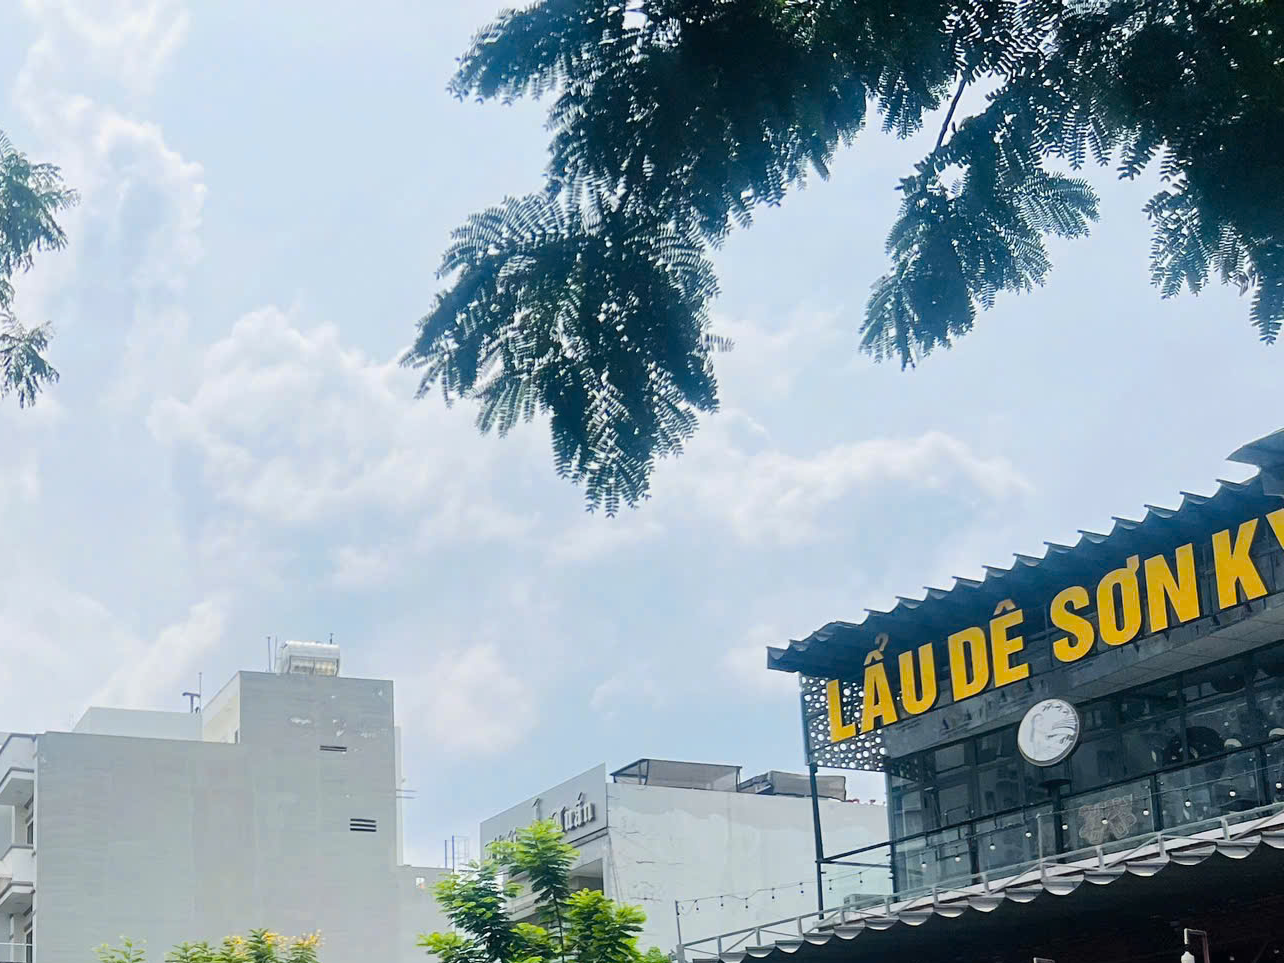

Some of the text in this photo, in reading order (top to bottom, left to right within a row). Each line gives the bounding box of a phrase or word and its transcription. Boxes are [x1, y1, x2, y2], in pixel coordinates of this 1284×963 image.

[826, 633, 937, 743] LẨU
[948, 599, 1030, 702] DÊ
[1050, 543, 1200, 662] SƠN
